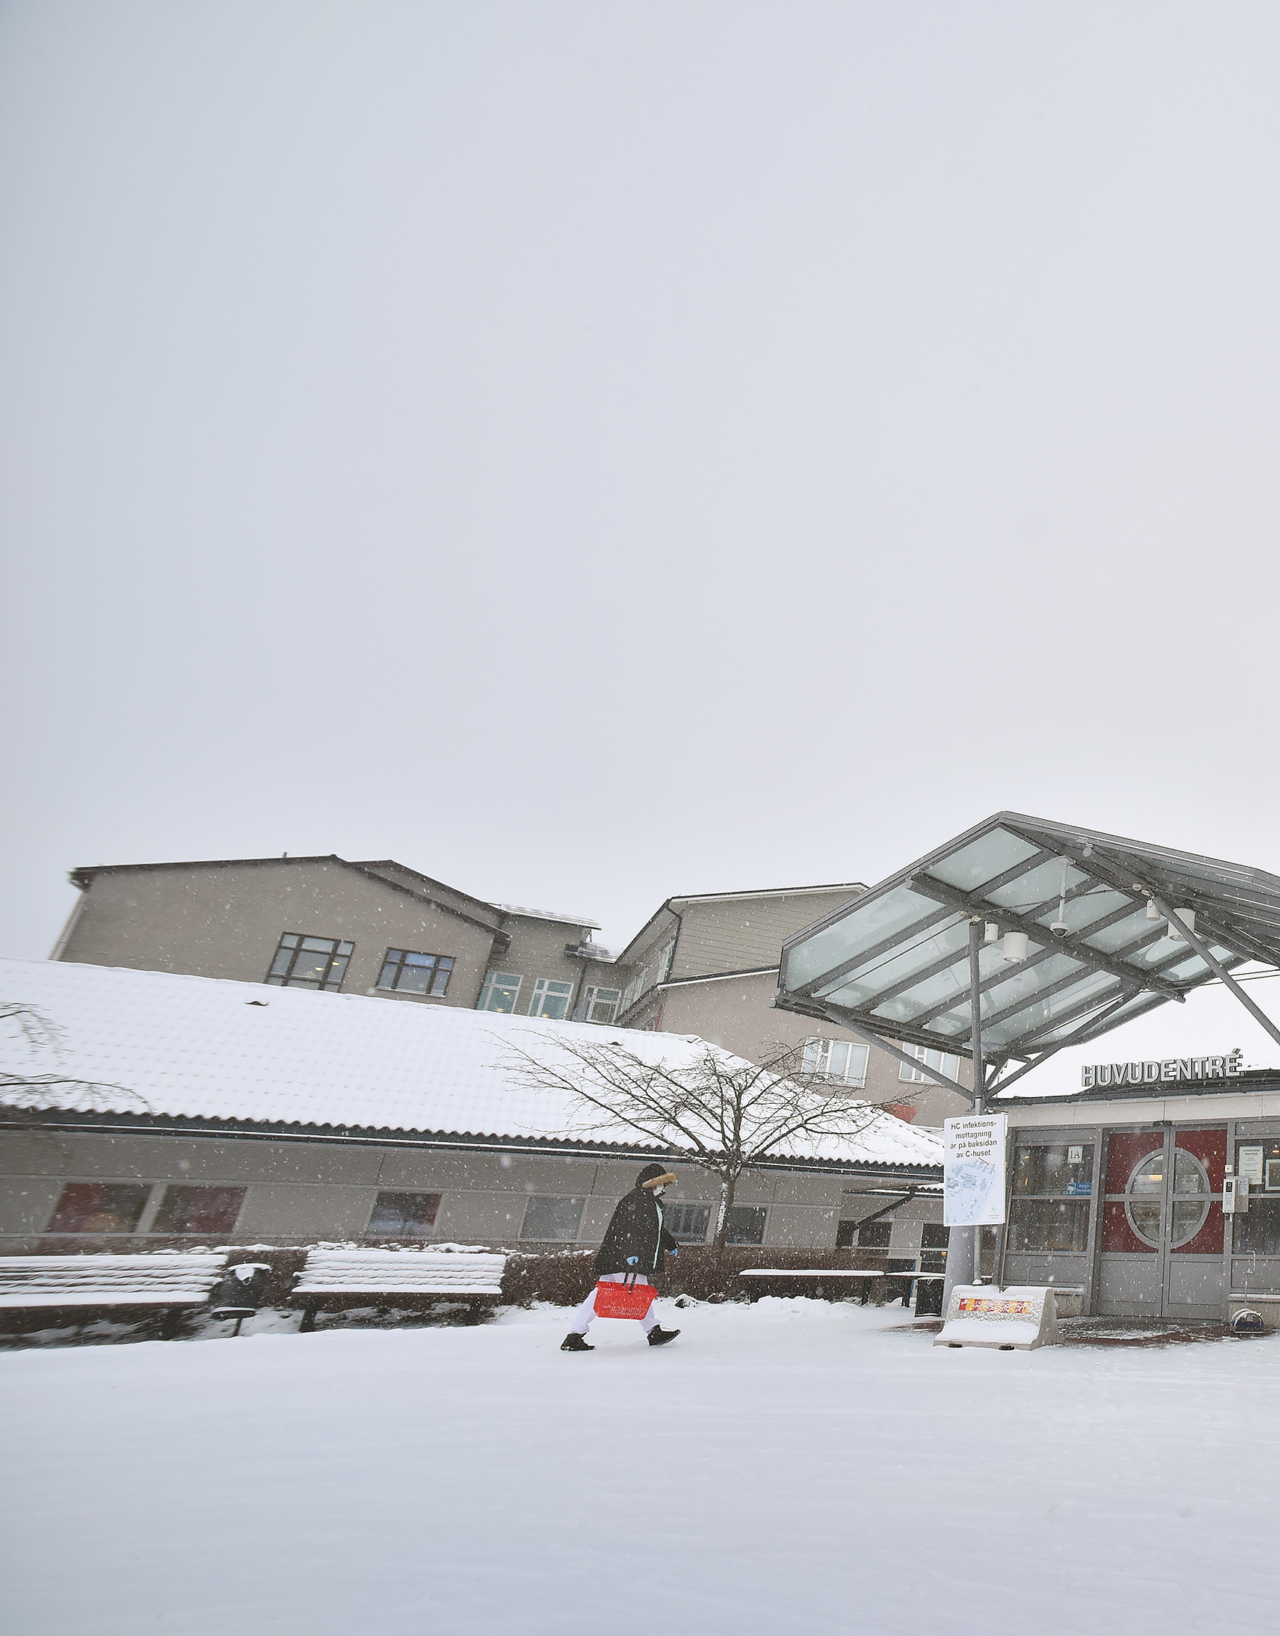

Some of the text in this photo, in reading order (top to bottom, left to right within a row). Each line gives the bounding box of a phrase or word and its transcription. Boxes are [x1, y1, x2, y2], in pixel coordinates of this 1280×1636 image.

[1081, 1048, 1243, 1087] HUVUDENTRÉ
[951, 1120, 997, 1130] HC infektions-
[955, 1130, 992, 1139] mottagning
[958, 1141, 967, 1150] på
[967, 1139, 998, 1148] baksidan
[965, 1149, 991, 1157] C-huset
